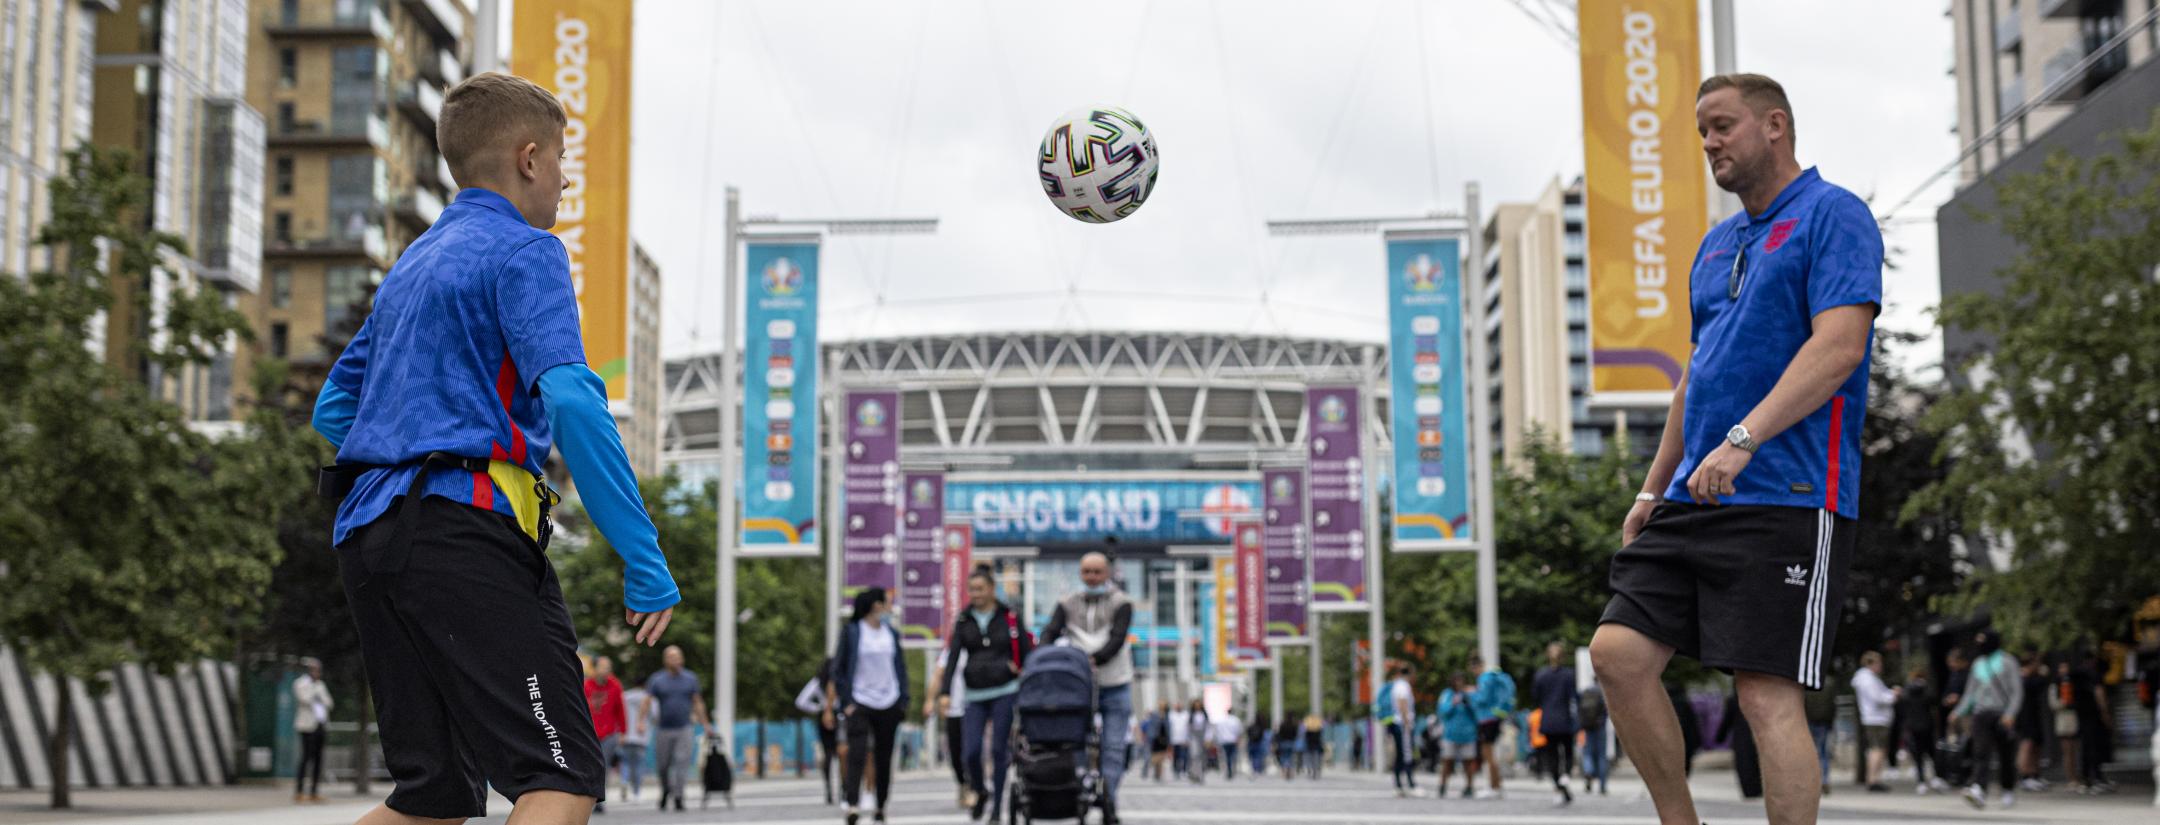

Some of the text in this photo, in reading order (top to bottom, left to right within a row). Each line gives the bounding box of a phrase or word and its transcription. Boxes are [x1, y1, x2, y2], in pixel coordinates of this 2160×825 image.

[554, 18, 588, 115] 2020
[556, 118, 587, 222] EURO
[1623, 12, 1668, 318] UEFA EURO 2020
[972, 488, 1161, 532] ENGLAND
[526, 673, 542, 700] THE
